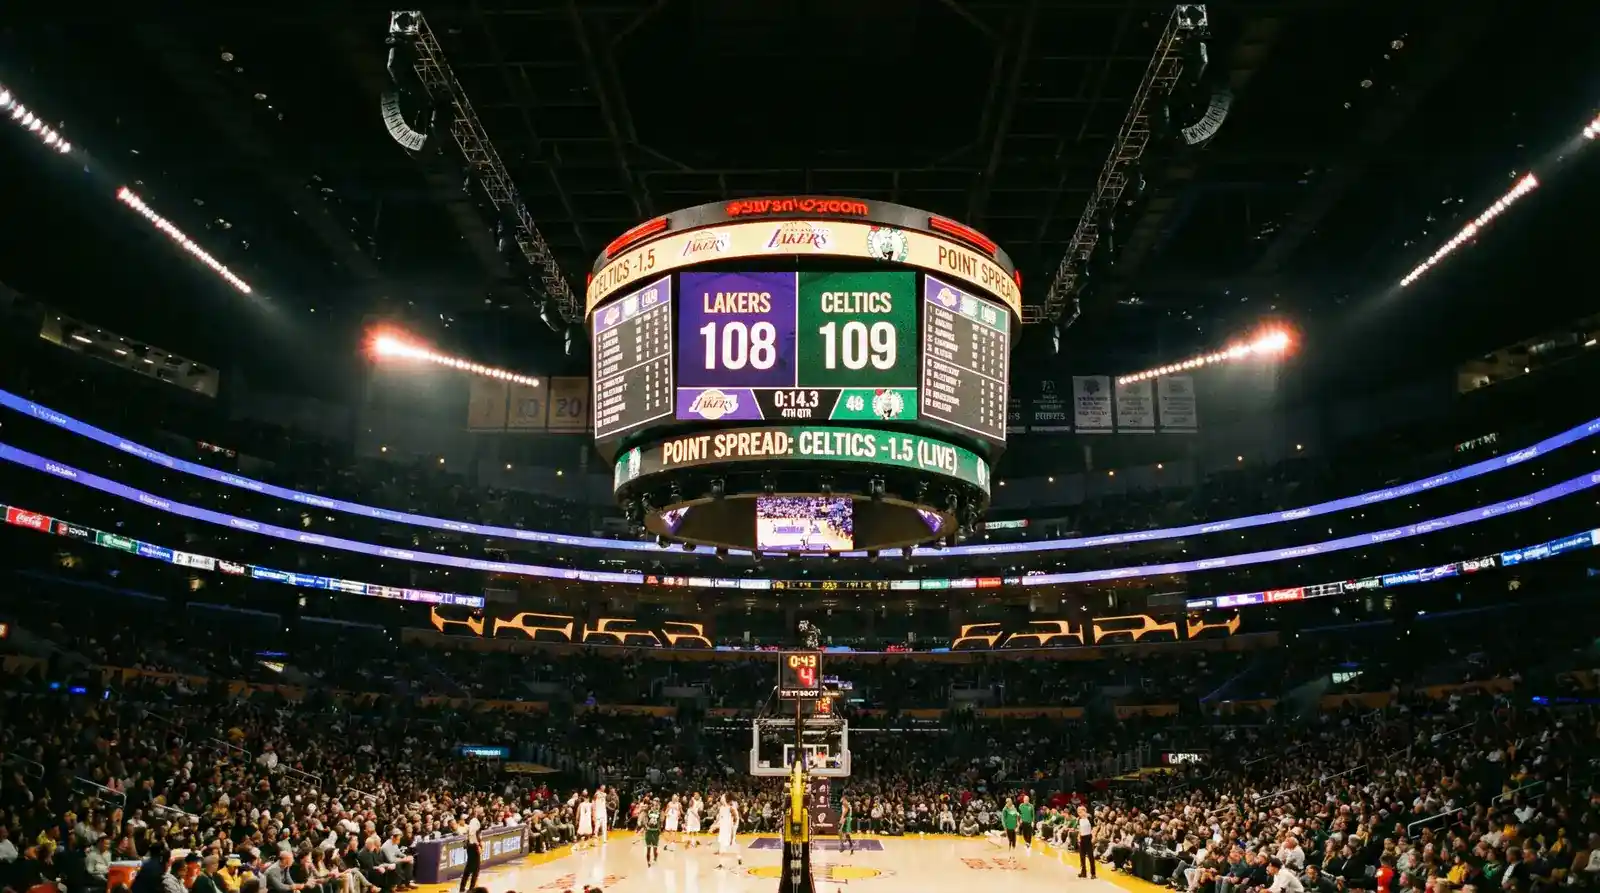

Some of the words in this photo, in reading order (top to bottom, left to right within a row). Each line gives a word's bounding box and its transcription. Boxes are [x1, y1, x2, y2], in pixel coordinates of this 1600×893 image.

[938, 245, 978, 278] POINT
[594, 259, 630, 300] CELTICS
[633, 248, 656, 272] -1.5
[703, 292, 772, 313] LAKERS
[821, 292, 892, 313] CELTICS
[700, 321, 776, 370] 108
[819, 321, 897, 370] 109
[774, 391, 819, 408] 0:14.3
[781, 408, 797, 418] 4TH
[798, 408, 812, 418] QTR
[662, 436, 711, 465] POINT
[714, 432, 794, 458] SPREAD:
[799, 431, 876, 457] CELTICS
[880, 437, 913, 460] -1.5
[917, 441, 958, 475] (LIVE)
[789, 655, 817, 667] 0:43
[800, 668, 814, 686] 4
